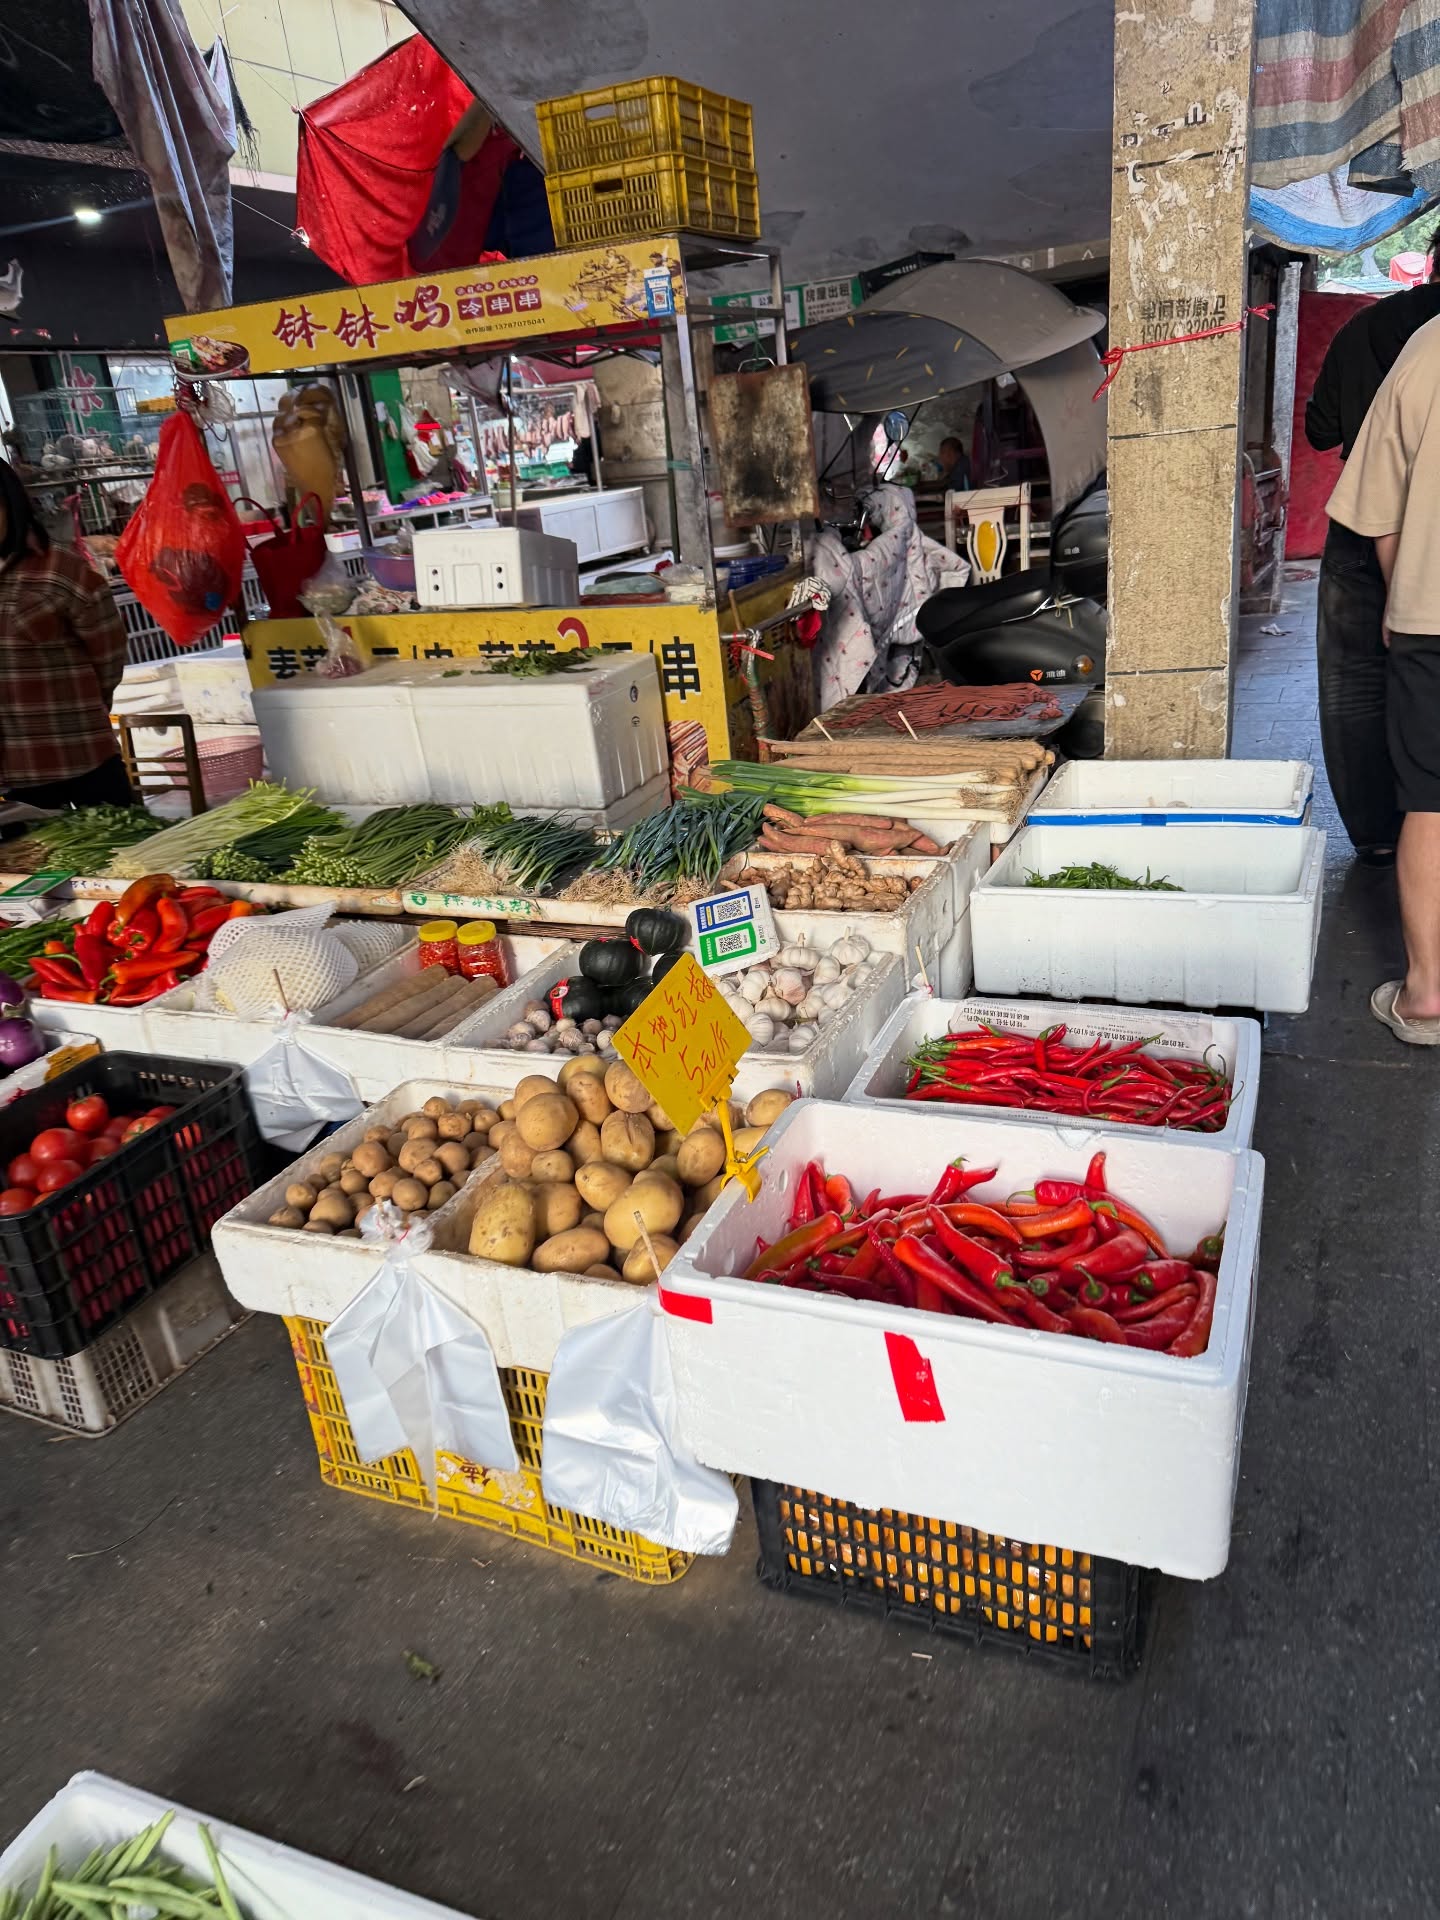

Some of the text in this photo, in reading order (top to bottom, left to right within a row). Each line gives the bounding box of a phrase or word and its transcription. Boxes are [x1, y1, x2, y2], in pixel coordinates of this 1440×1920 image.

[459, 288, 541, 319] 冷串串
[805, 282, 850, 303] 房屋出租
[272, 284, 451, 350] 钵钵鸡
